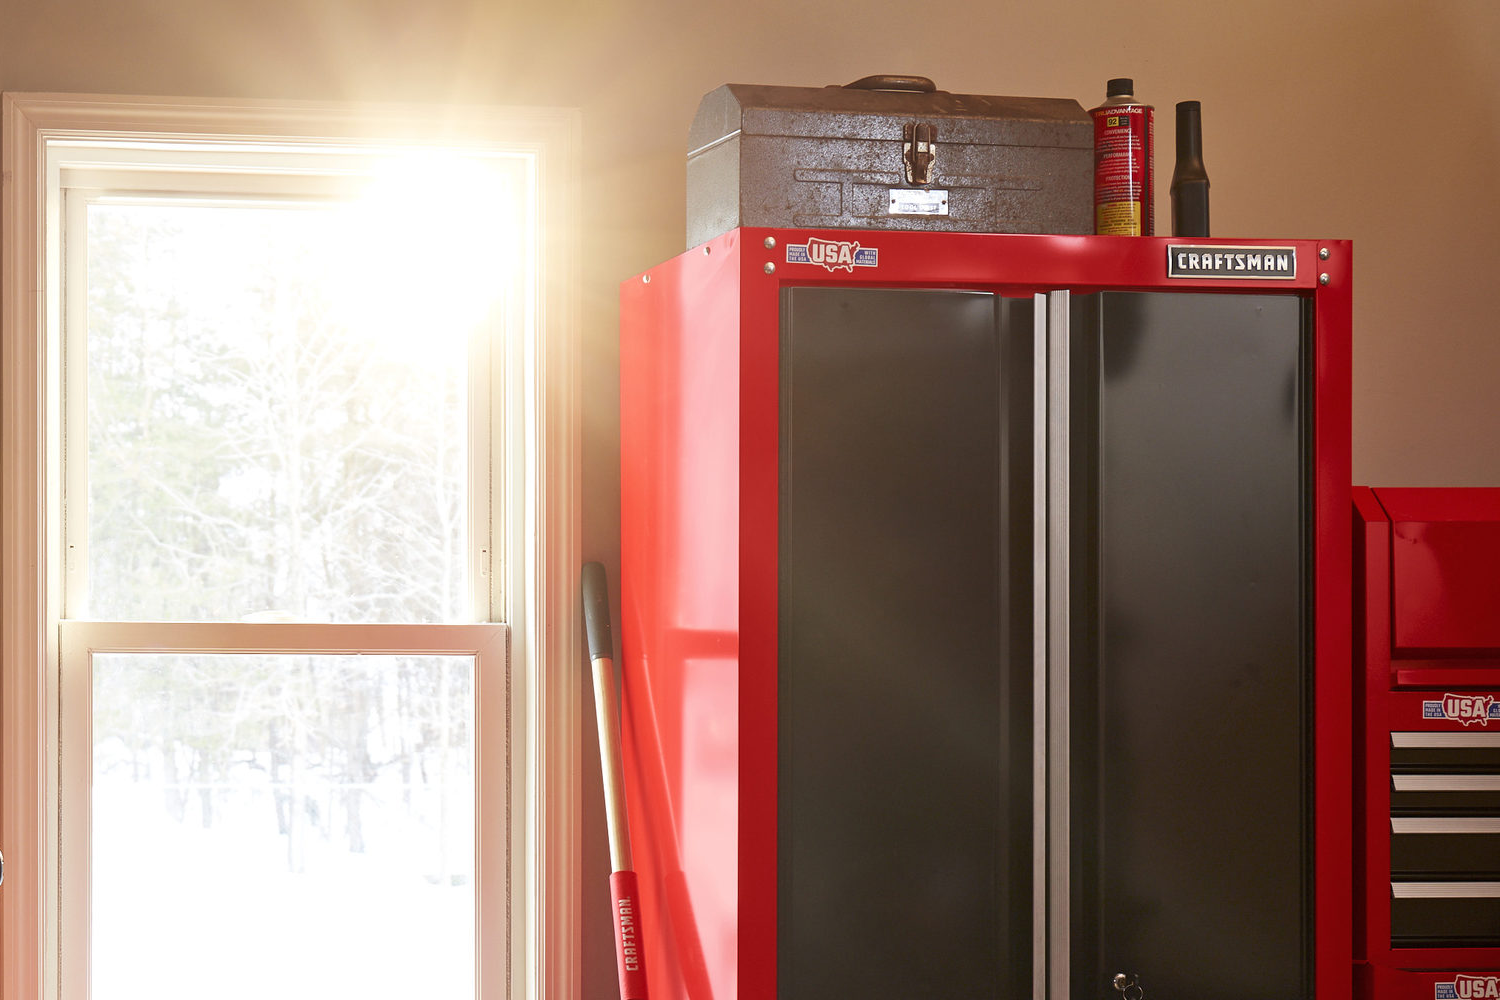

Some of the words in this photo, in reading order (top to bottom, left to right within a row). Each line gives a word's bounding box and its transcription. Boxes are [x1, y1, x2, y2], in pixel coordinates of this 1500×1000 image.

[1108, 118, 1117, 126] 92
[812, 243, 853, 264] USA
[1177, 253, 1288, 271] CRAFTSMAN
[1447, 699, 1486, 717] USA
[618, 899, 638, 971] CRAFTSMAN
[1460, 980, 1499, 998] USA
